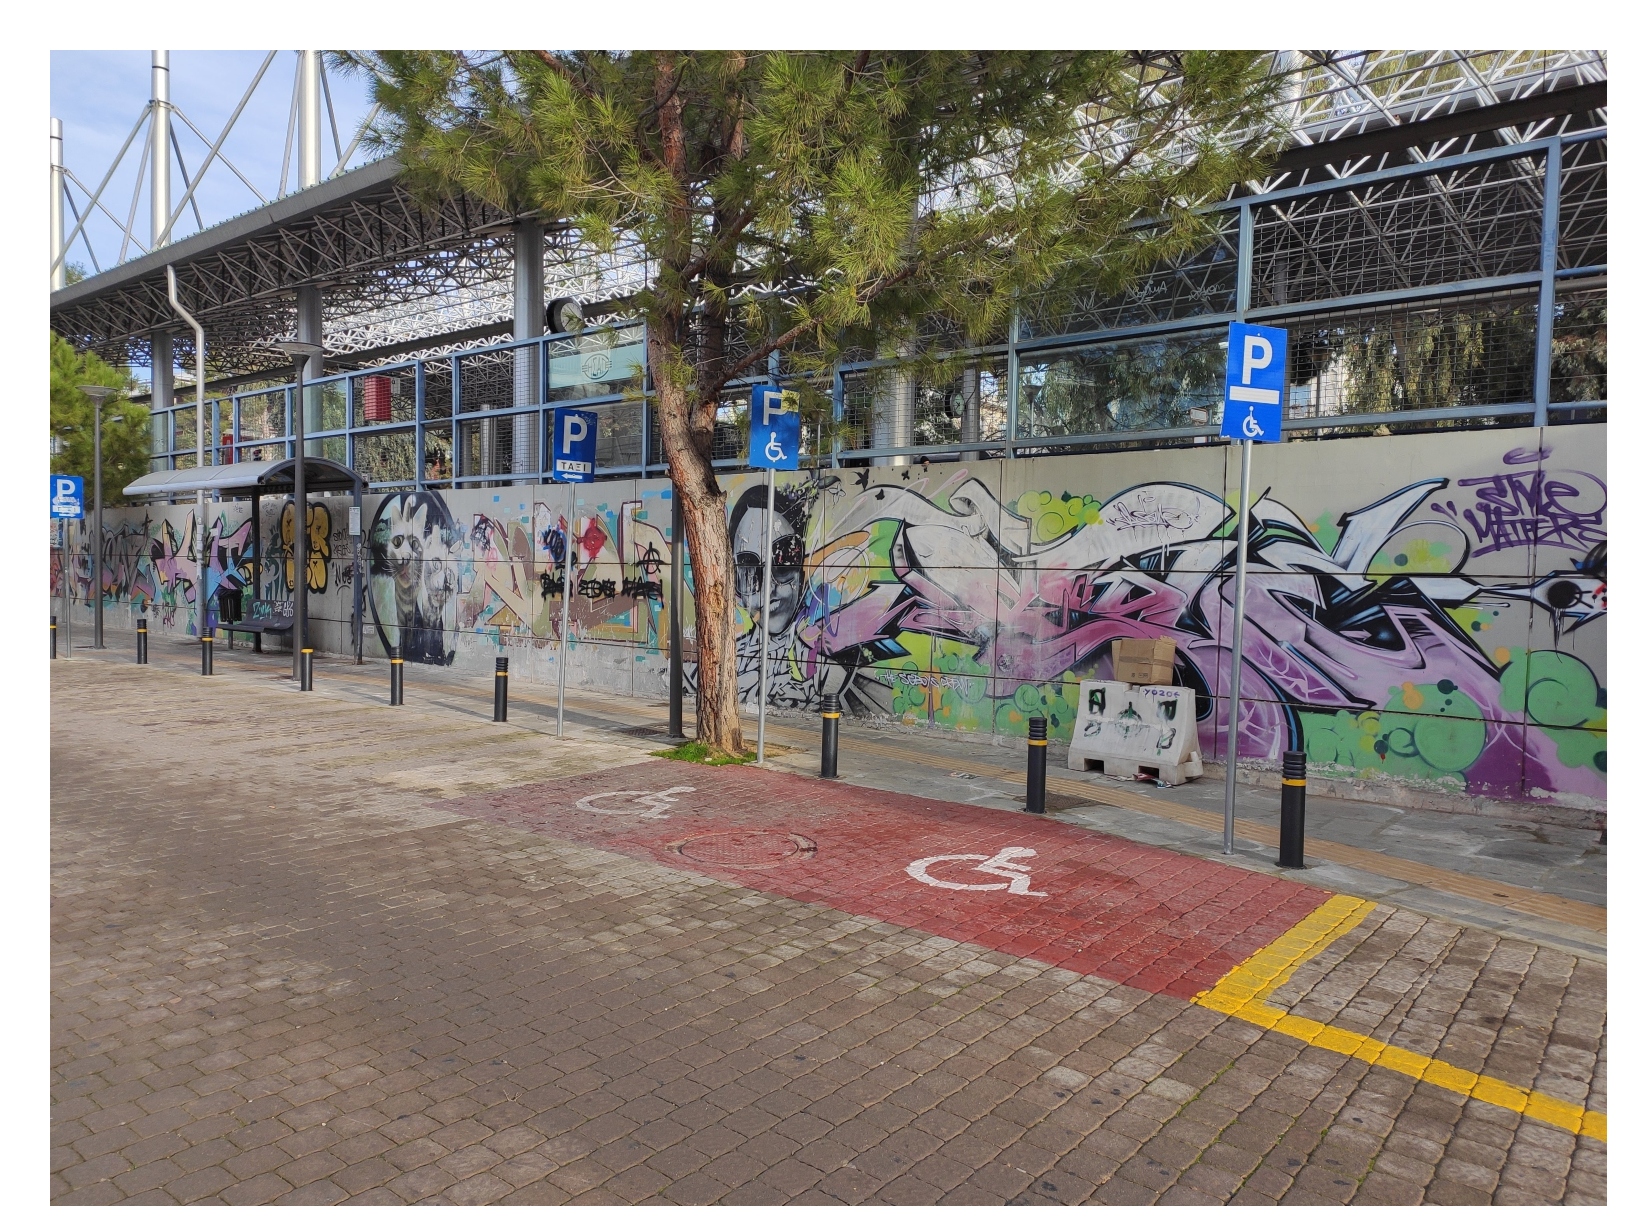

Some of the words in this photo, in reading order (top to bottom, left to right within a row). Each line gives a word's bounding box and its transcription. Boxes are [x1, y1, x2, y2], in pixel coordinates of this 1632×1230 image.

[1241, 334, 1273, 385] P
[762, 390, 791, 425] P
[562, 415, 588, 454] P
[560, 461, 587, 472] ΤΑΞΙ
[56, 479, 76, 499] P
